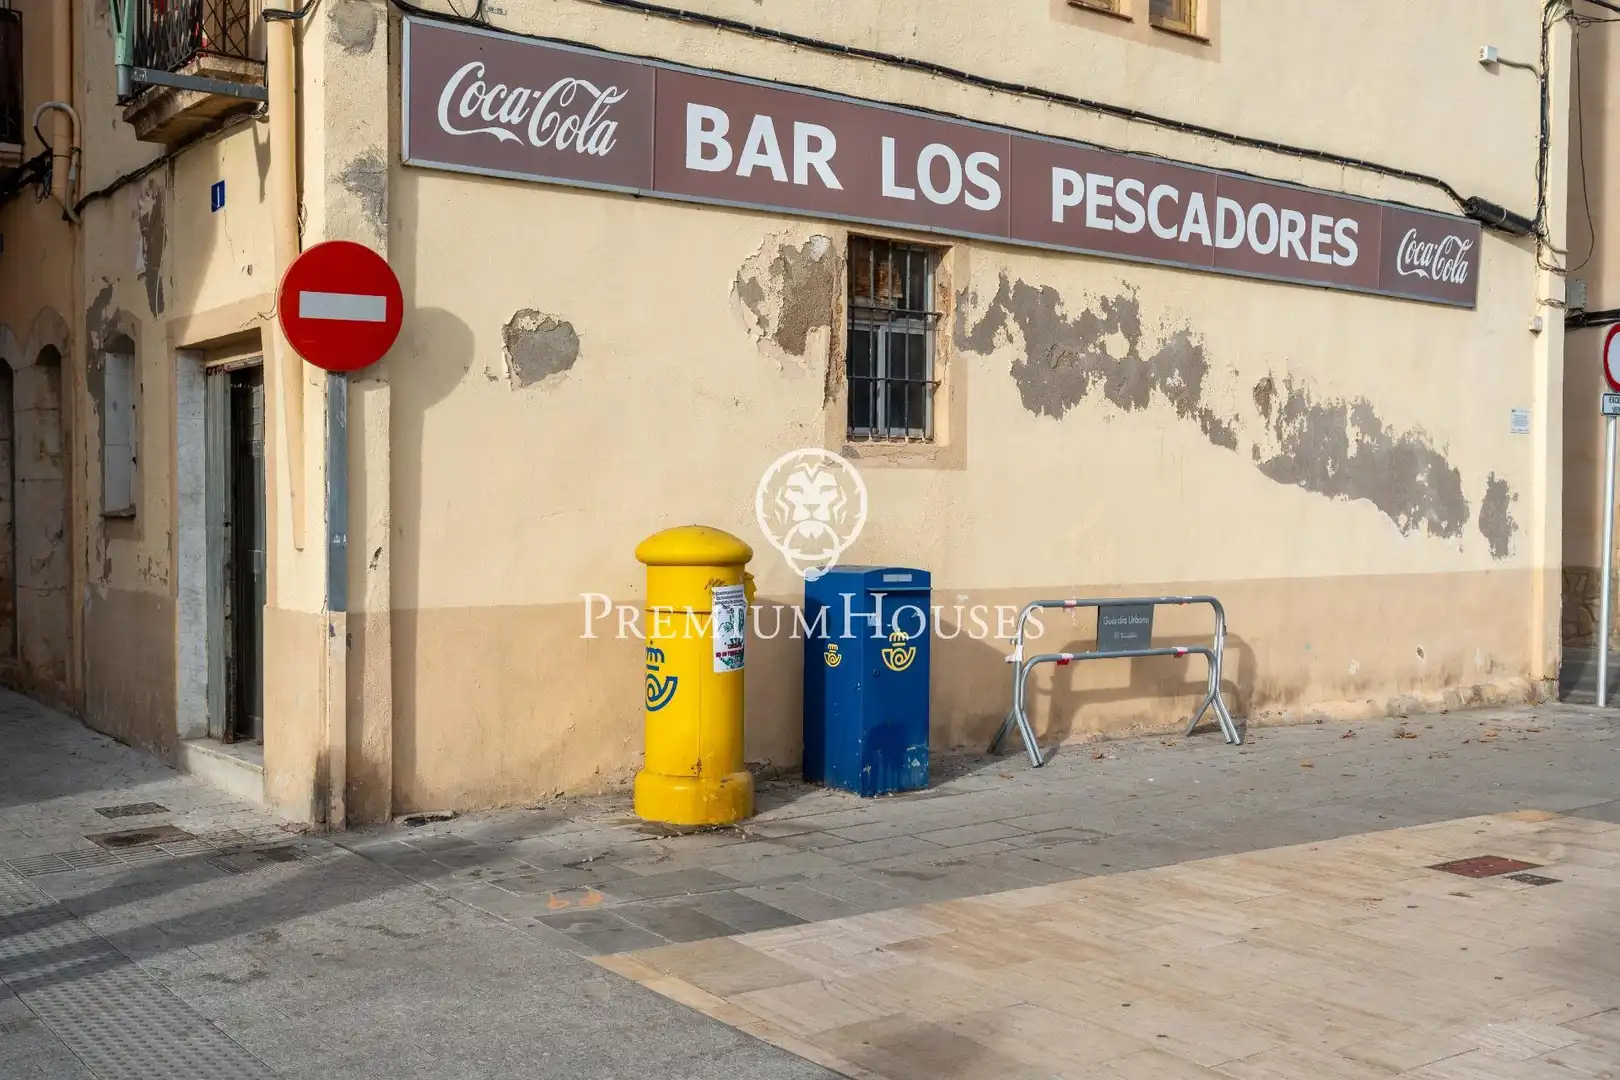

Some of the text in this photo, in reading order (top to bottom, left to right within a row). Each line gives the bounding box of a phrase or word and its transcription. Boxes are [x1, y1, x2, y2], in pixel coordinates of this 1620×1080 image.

[437, 61, 629, 157] Coca-Cola
[686, 102, 1359, 267] BAR LOS PESCADORES
[1397, 228, 1474, 285] Coca-Cola
